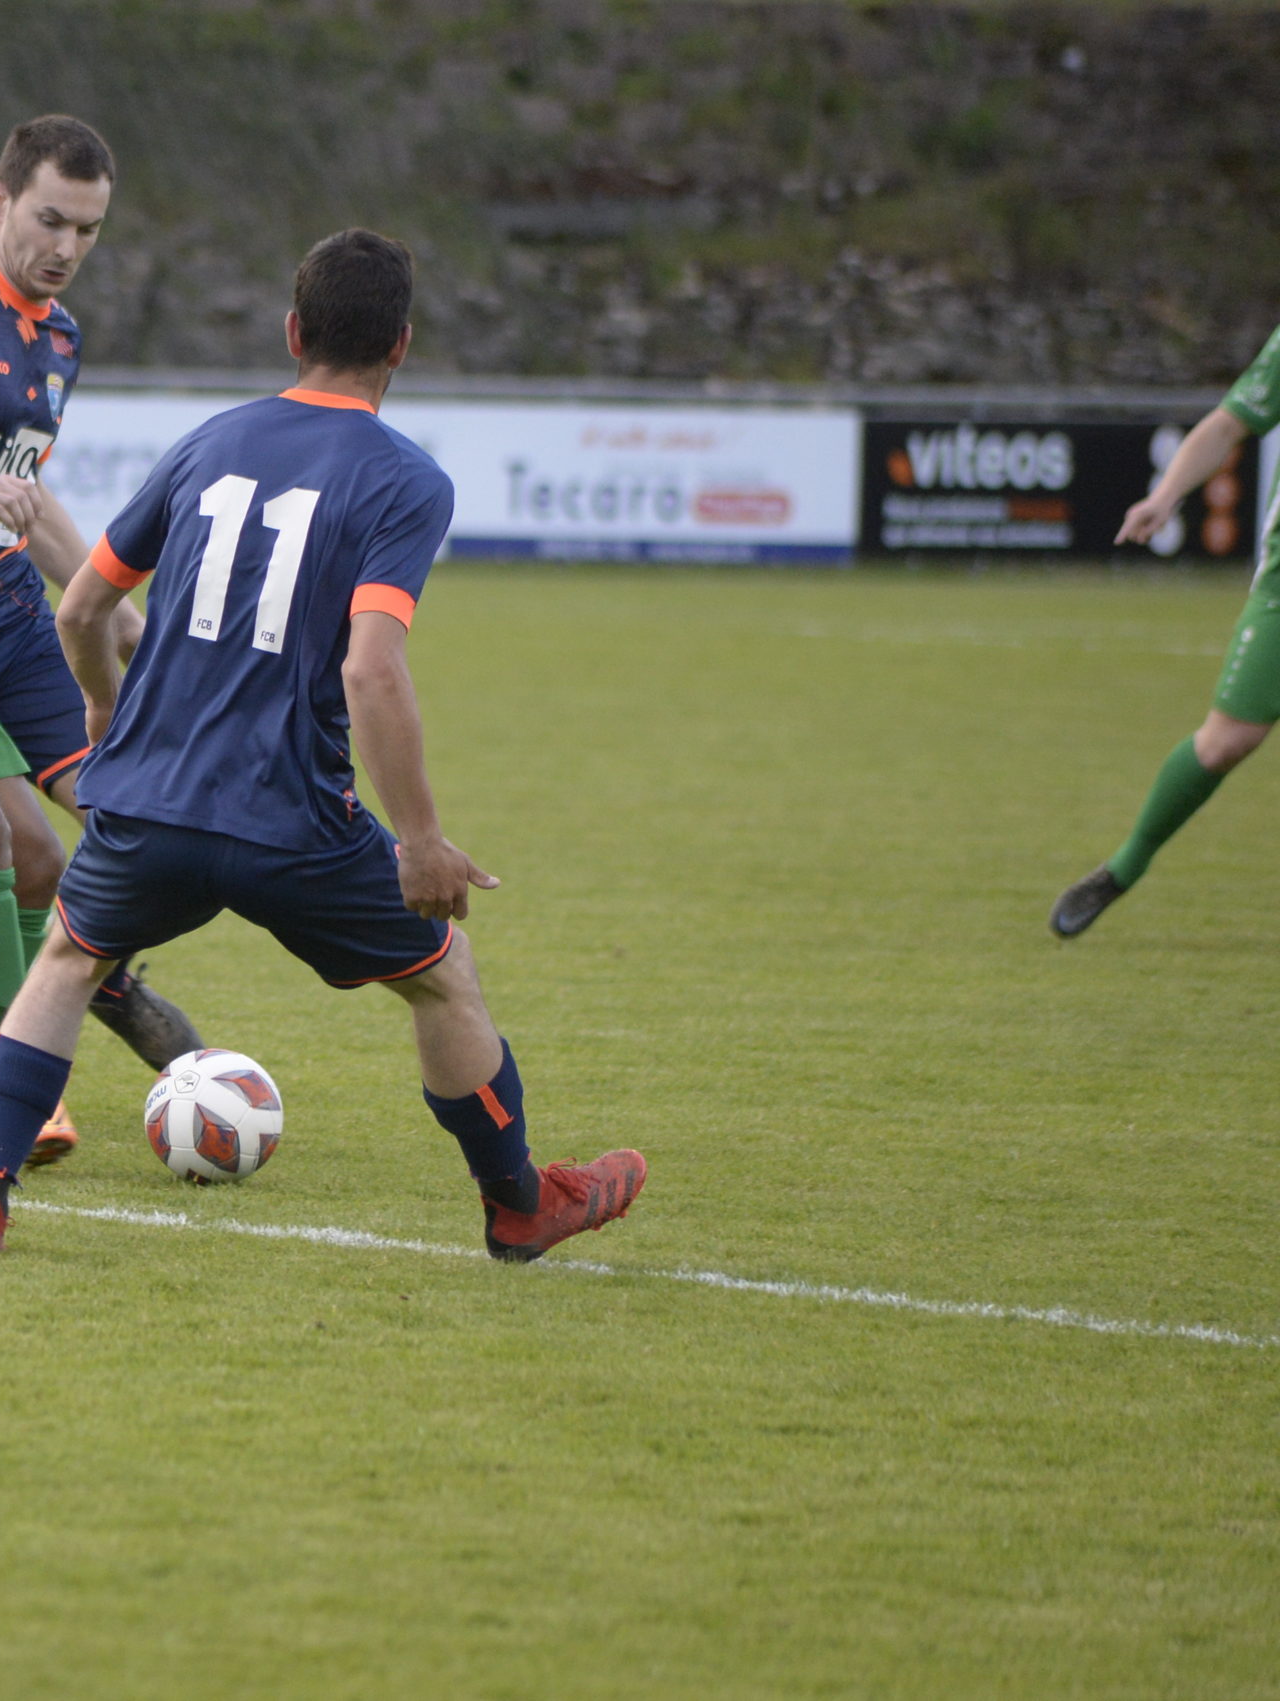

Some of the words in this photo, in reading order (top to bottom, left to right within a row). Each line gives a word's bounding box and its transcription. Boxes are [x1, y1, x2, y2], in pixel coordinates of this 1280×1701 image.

[507, 453, 684, 523] Tecaro
[906, 420, 1073, 491] viteos
[187, 473, 321, 655] 11
[196, 617, 213, 632] FCB
[259, 630, 276, 644] FCB
